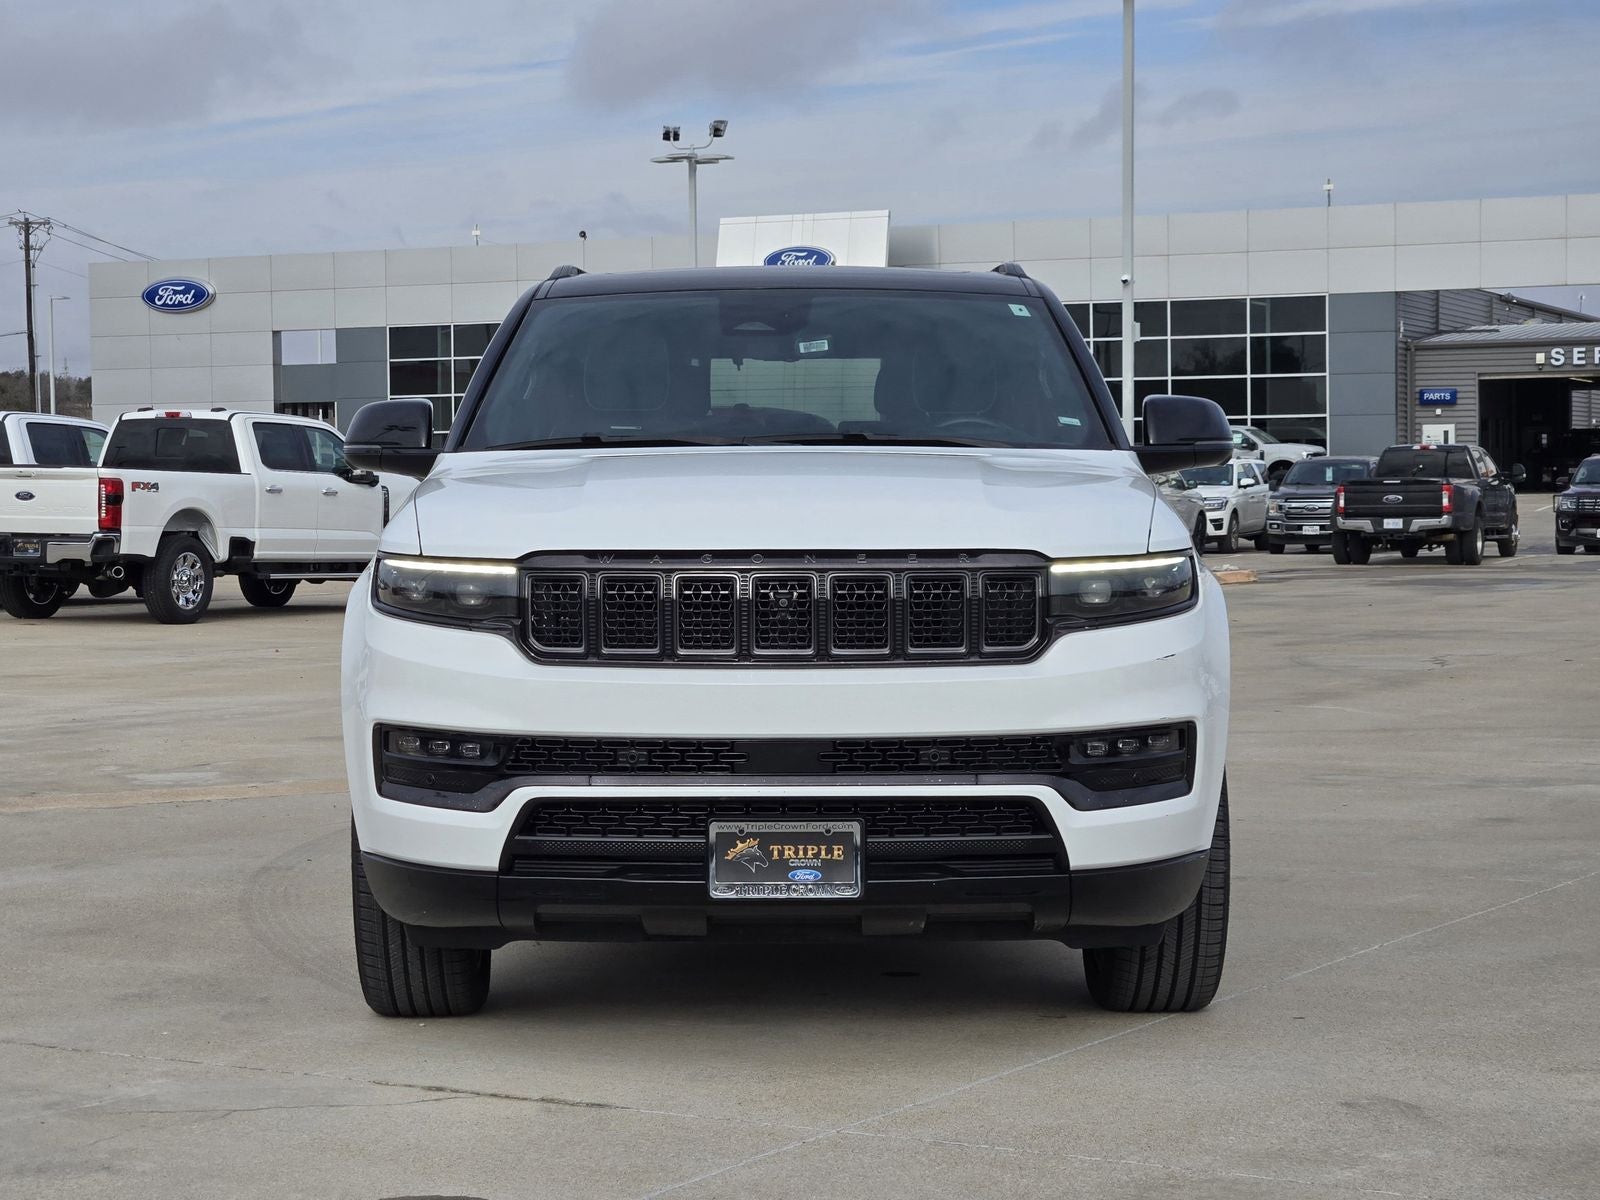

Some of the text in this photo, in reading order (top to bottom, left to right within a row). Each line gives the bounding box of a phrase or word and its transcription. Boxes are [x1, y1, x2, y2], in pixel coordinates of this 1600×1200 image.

[155, 285, 195, 305] Ford
[1424, 392, 1451, 401] PARTS
[131, 481, 159, 492] FX4
[598, 553, 969, 565] WAGONEER
[769, 845, 844, 860] TRIPLE
[788, 858, 822, 867] CROWN
[794, 871, 816, 880] Ford
[735, 884, 787, 897] TRIPLE
[789, 884, 836, 897] CROWN
